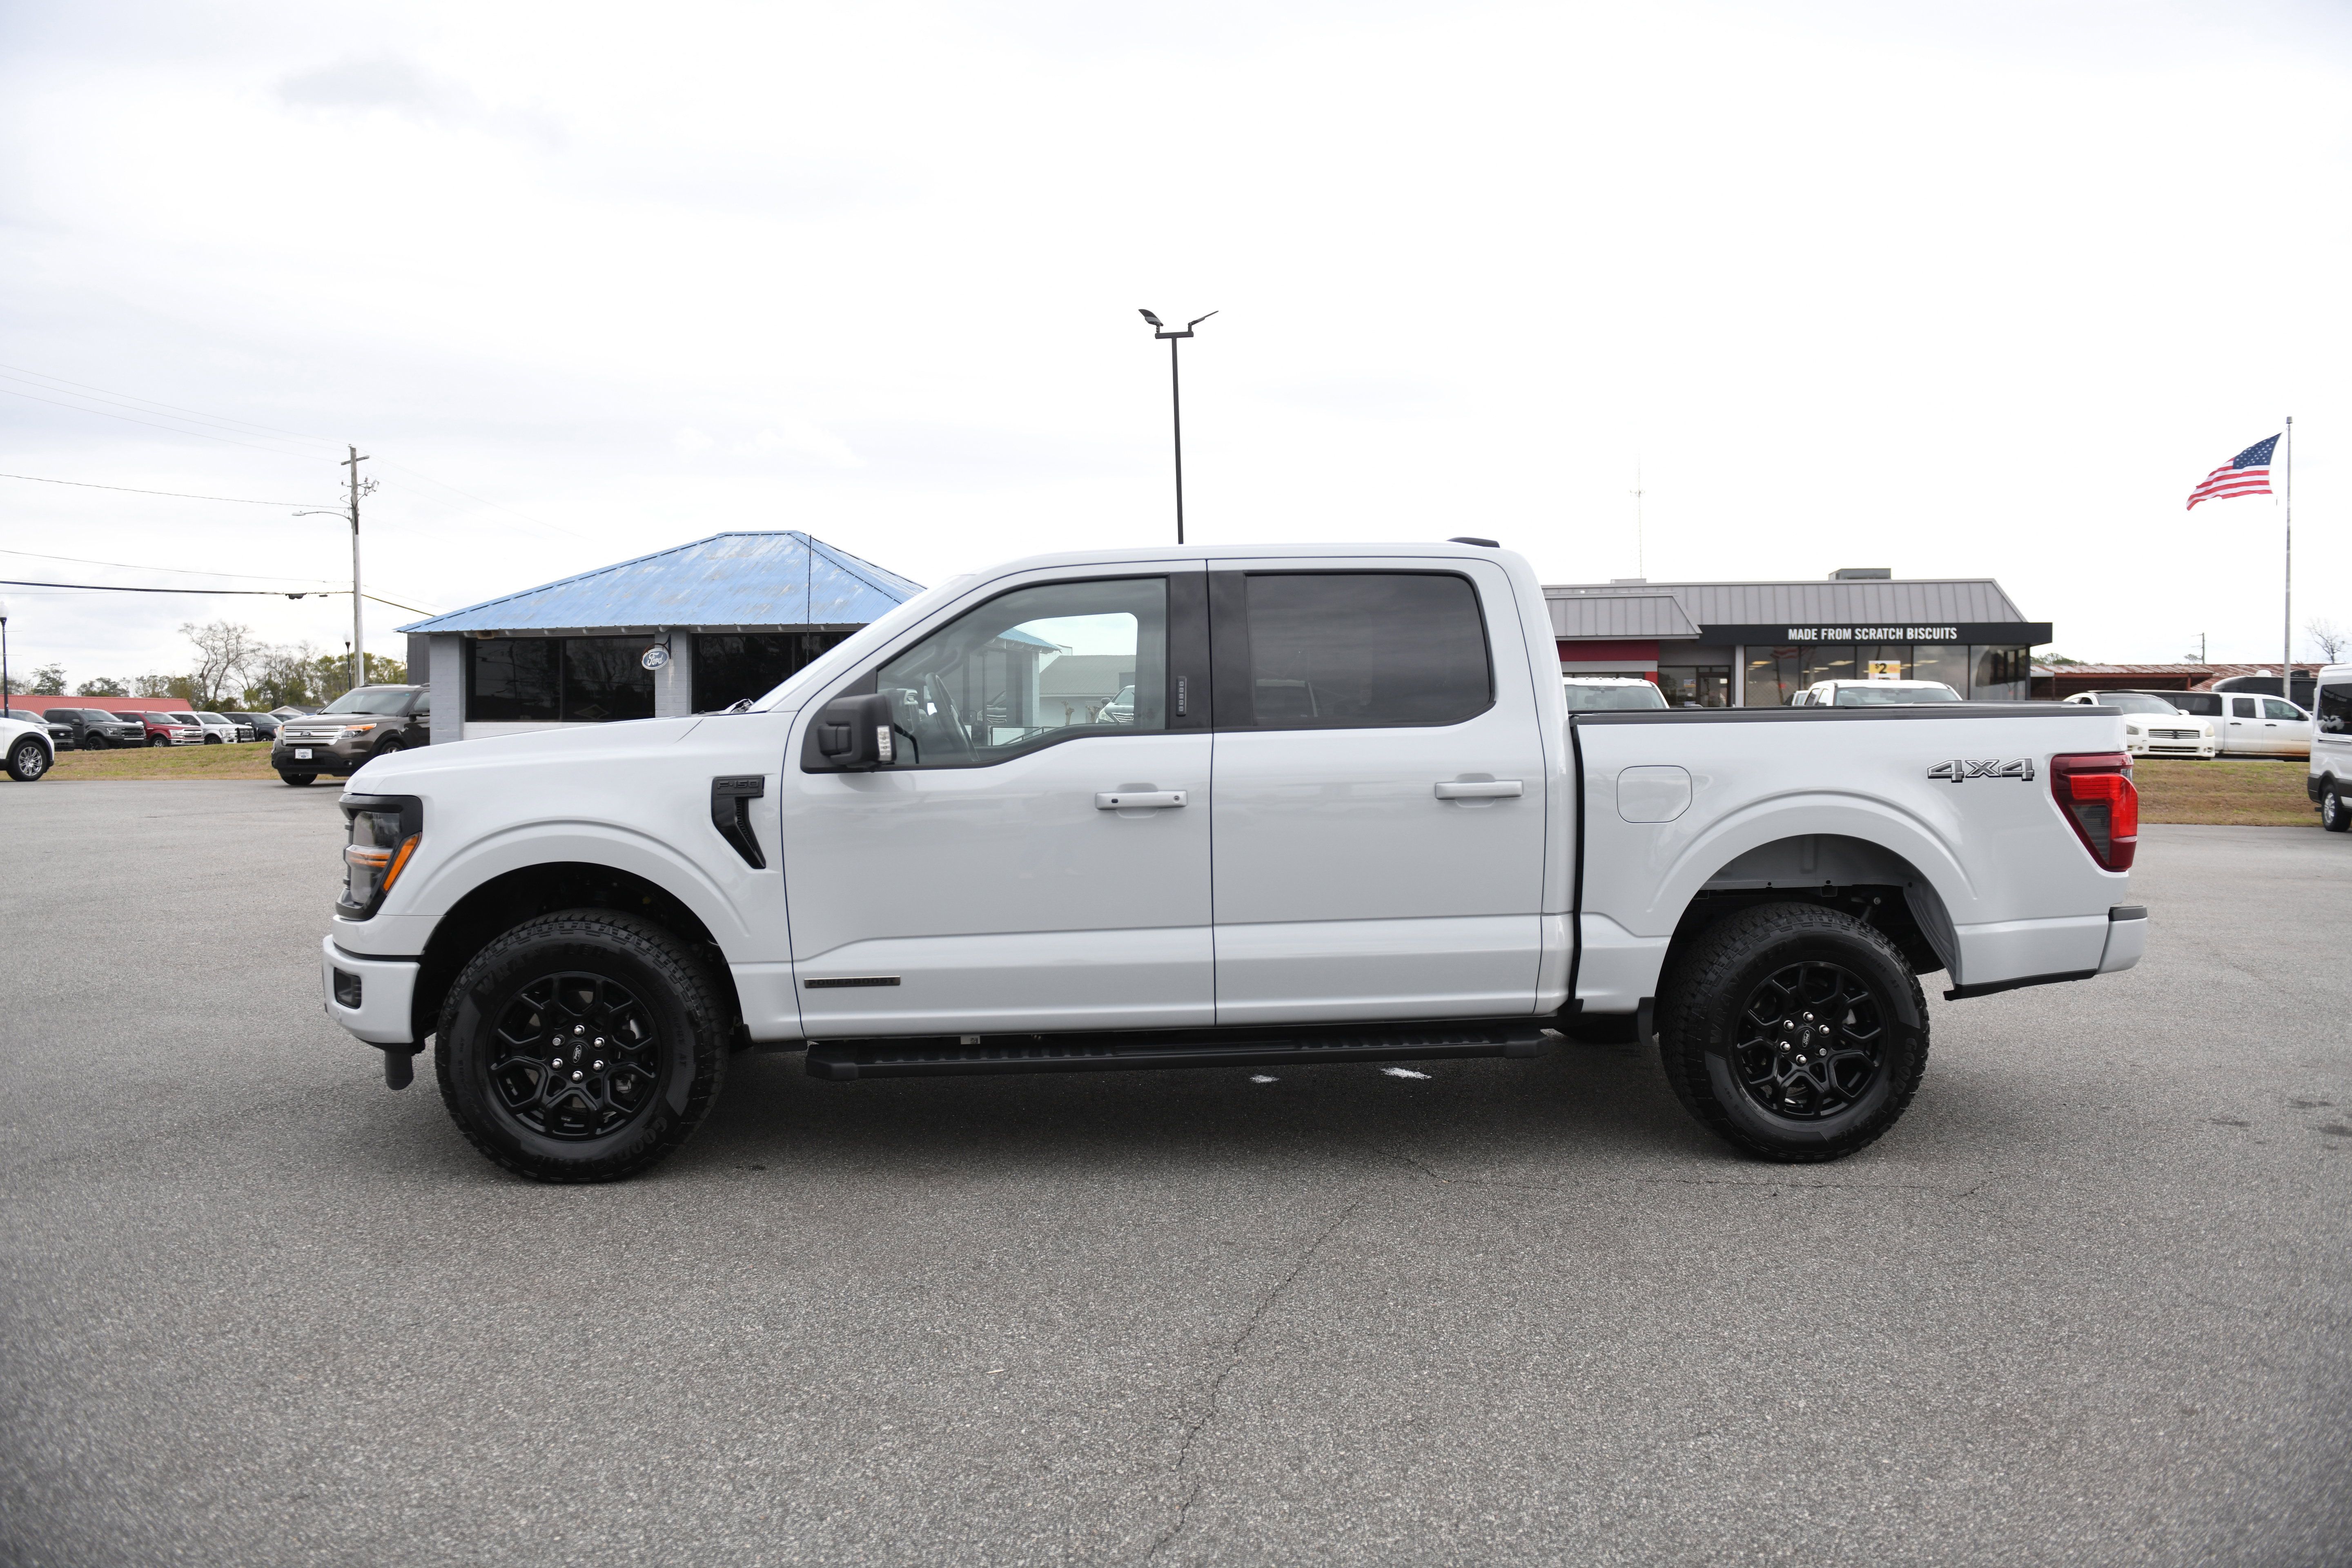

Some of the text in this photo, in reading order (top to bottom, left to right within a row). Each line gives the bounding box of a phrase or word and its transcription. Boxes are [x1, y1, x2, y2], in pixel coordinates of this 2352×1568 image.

[1788, 627, 1957, 640] MADE FROM SCRATCH BISCUITS
[647, 653, 664, 666] Ford
[1875, 663, 1887, 674] $2
[717, 780, 760, 788] F-150
[475, 942, 608, 996] WRANLER
[808, 977, 895, 986] POWERBOOST
